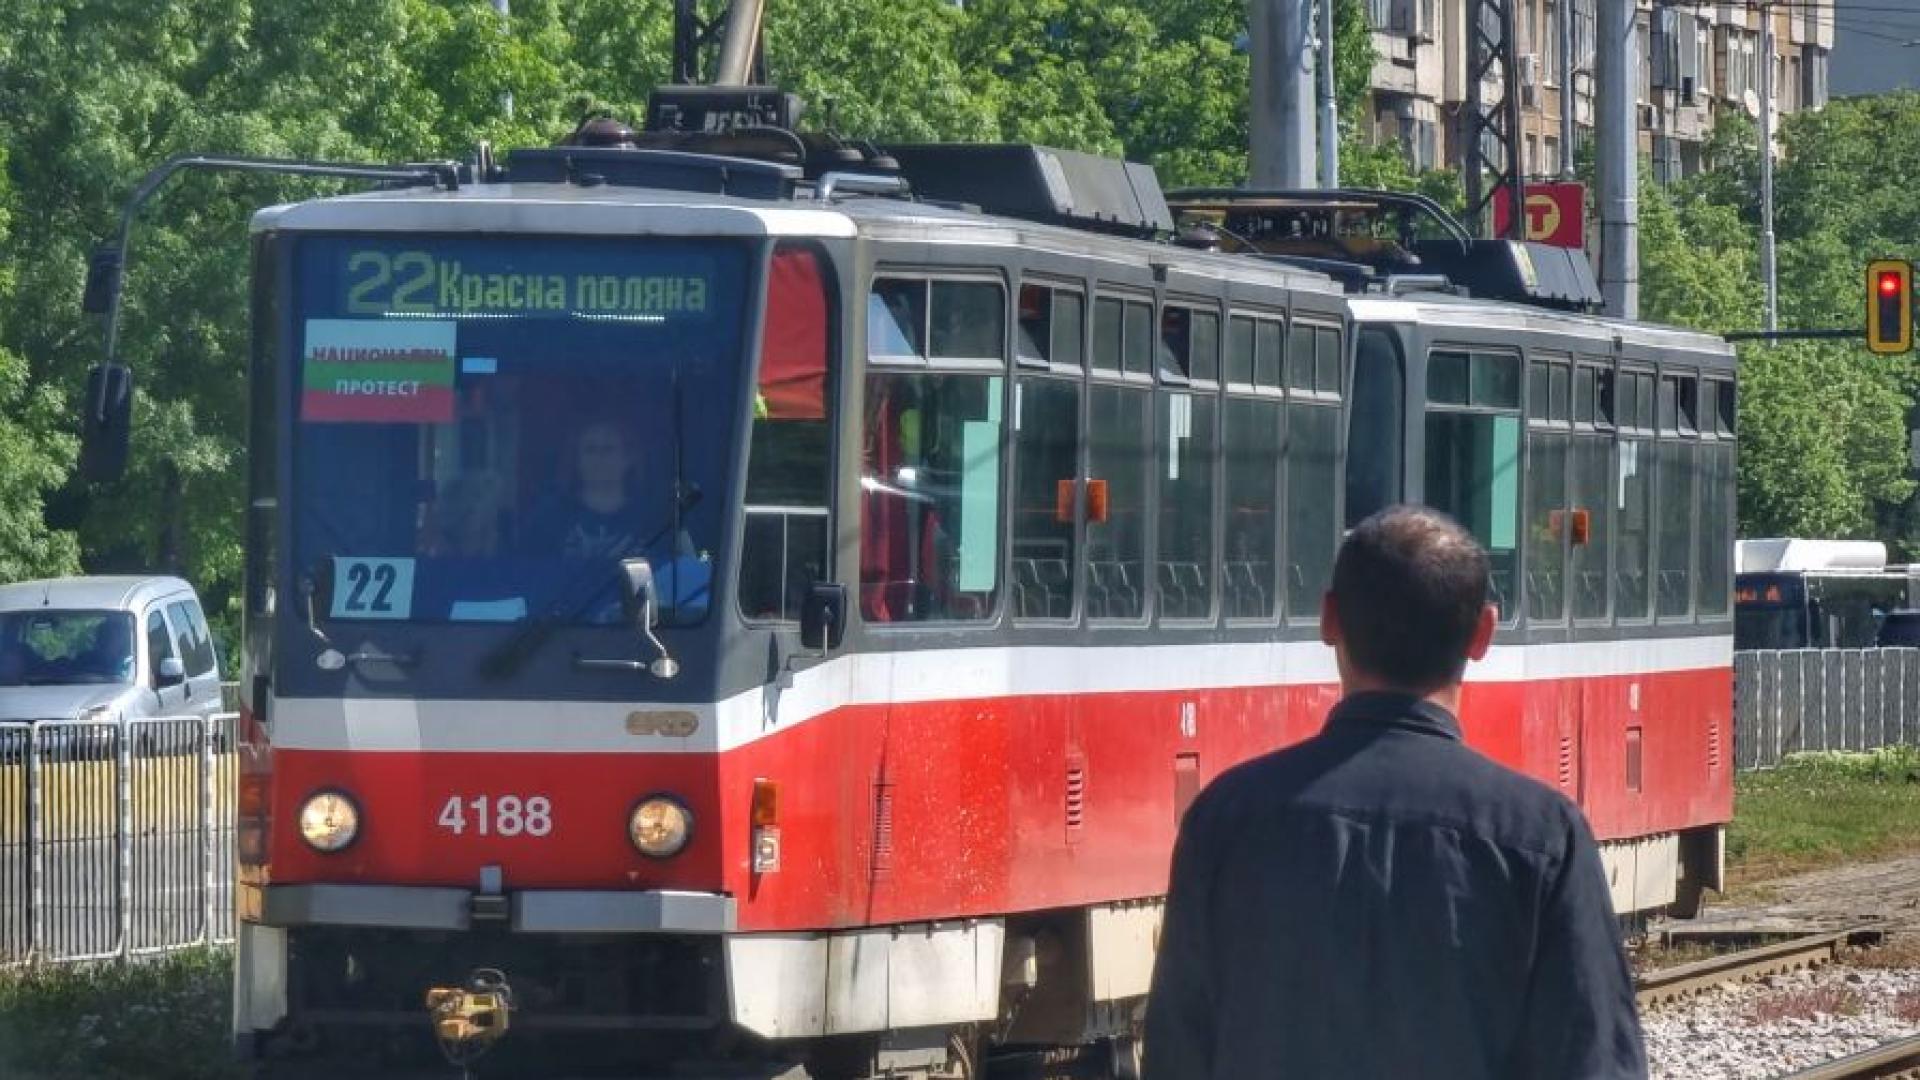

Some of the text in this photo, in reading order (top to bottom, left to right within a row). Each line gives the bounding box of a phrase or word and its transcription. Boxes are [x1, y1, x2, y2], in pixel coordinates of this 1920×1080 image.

[349, 251, 706, 313] 22 Красна поляна
[335, 379, 419, 395] ПРОТЕСТ
[345, 563, 396, 611] 22
[438, 794, 552, 836] 4188
